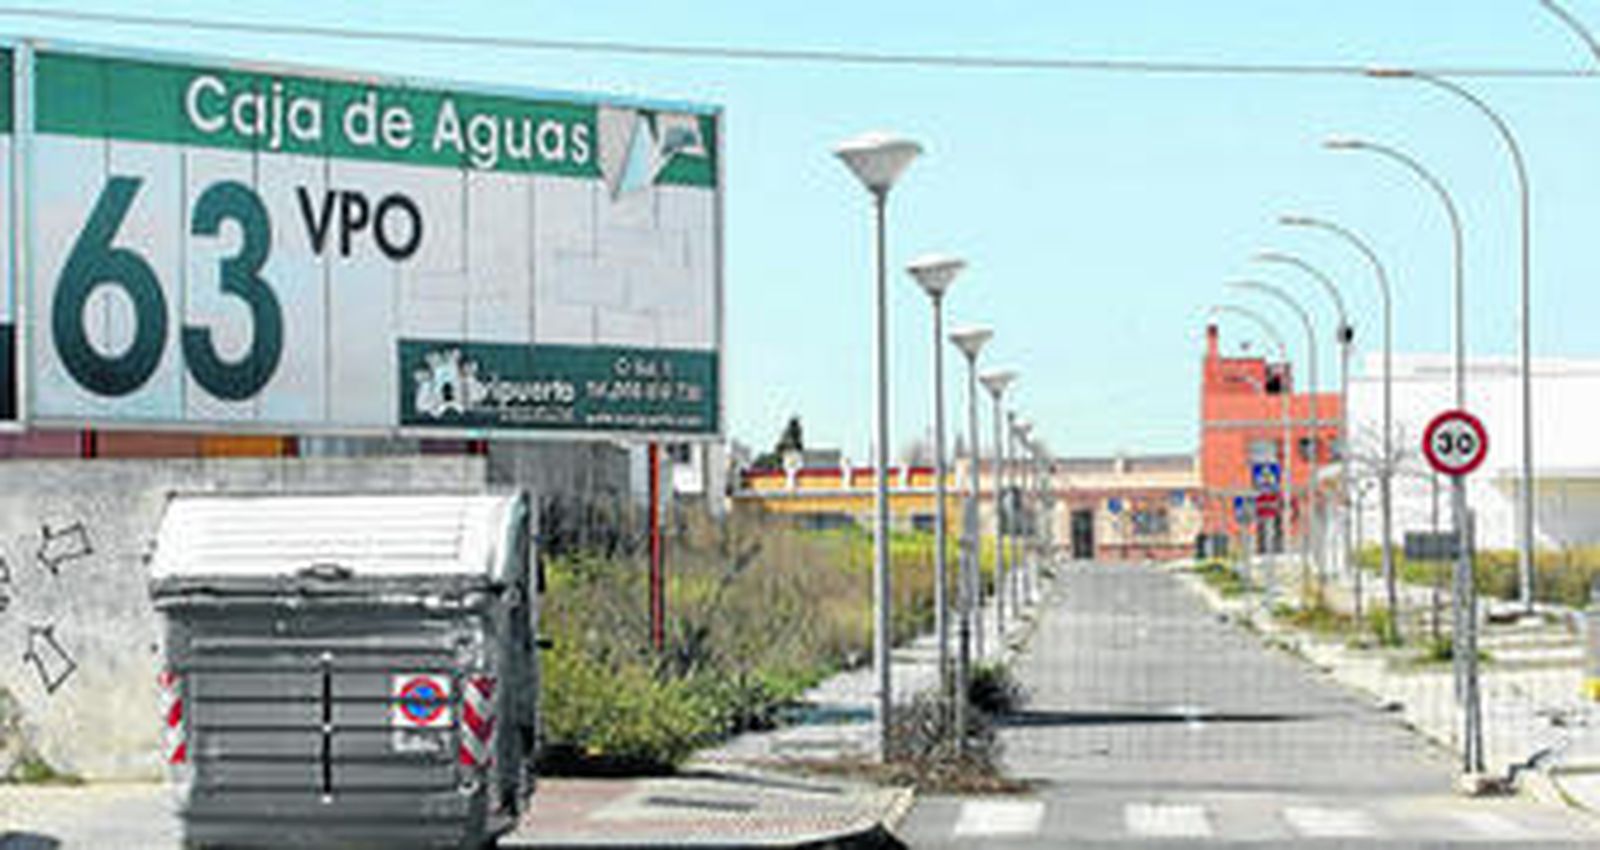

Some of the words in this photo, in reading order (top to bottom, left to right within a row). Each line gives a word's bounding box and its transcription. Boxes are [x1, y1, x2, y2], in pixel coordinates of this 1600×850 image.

[186, 75, 322, 149] Caja
[343, 91, 414, 149] de
[432, 99, 591, 169] Aguas
[296, 186, 423, 261] VPO
[52, 175, 283, 401] 63
[1437, 431, 1474, 455] 30
